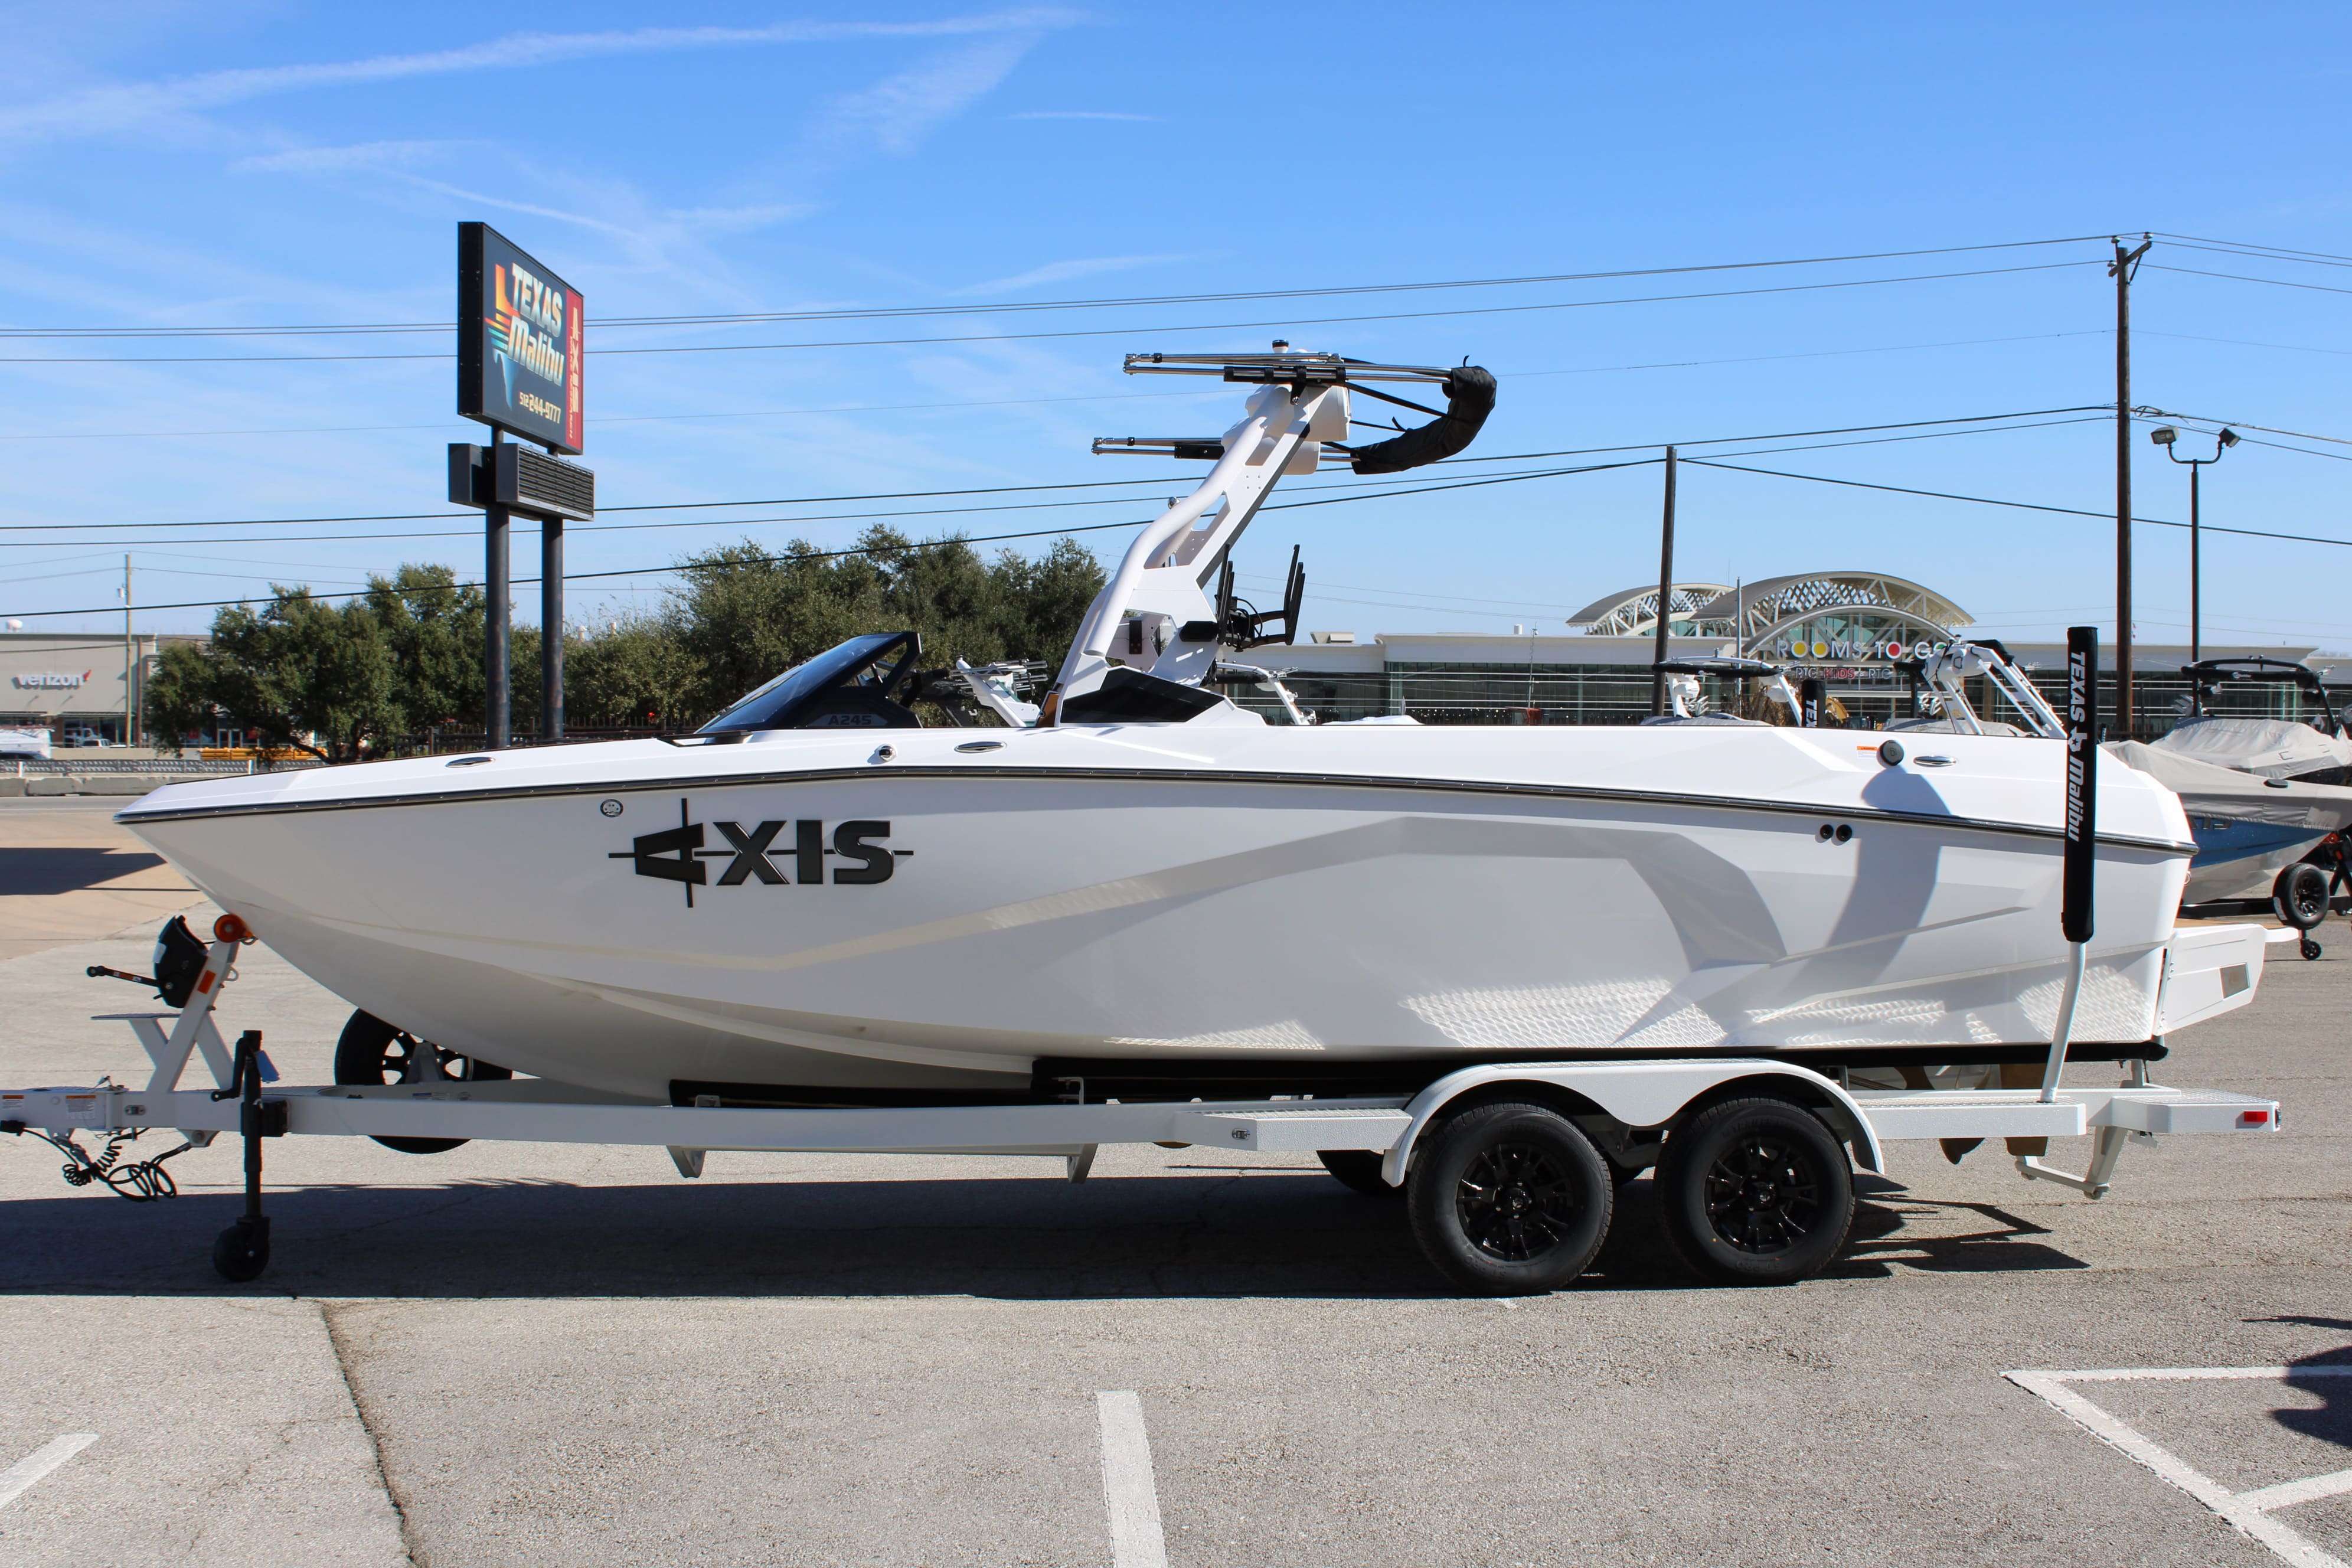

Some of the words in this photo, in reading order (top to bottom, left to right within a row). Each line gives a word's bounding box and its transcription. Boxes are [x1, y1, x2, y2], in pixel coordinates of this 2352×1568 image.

[512, 262, 563, 338] TEXAS
[508, 315, 565, 387] Malibu
[571, 306, 581, 413] AXIS
[17, 672, 84, 686] verizon
[1776, 641, 1861, 658] ROOMS
[1875, 641, 1902, 659] TO
[1824, 668, 1856, 680] KIDS
[828, 715, 872, 726] A245
[2070, 651, 2086, 723] TEXAS
[2068, 754, 2085, 842] Malibu
[632, 798, 896, 908] AXIS
